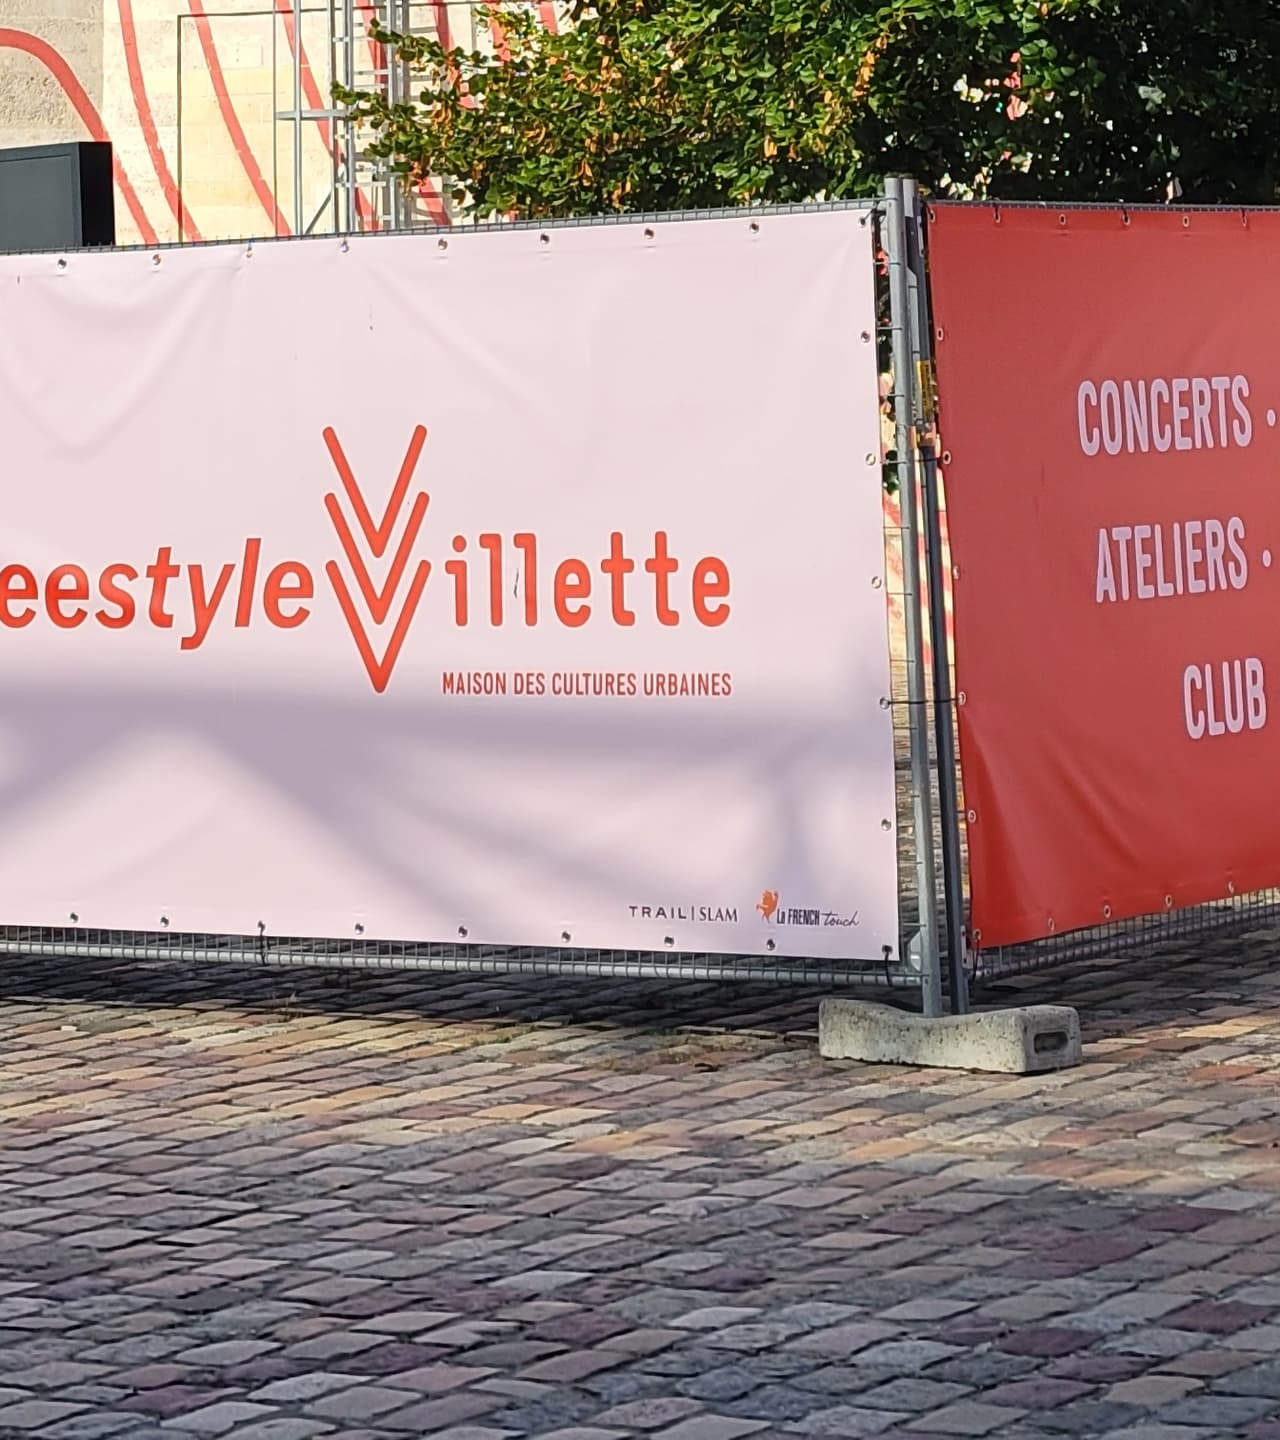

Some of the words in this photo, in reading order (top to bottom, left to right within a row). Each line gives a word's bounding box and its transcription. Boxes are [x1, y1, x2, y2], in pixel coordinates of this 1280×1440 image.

[1077, 374, 1252, 456] CONCERTS
[1096, 516, 1248, 603] ATELIERS
[442, 672, 507, 695] MAISON
[513, 672, 545, 695] DES
[552, 672, 636, 696] CULTURES
[644, 673, 732, 696] URBAINES
[1183, 657, 1267, 739] CLUB
[628, 905, 687, 920] TRAIL
[698, 906, 738, 923] SLAM
[787, 908, 820, 926] FRENCH
[821, 909, 860, 927] touch
